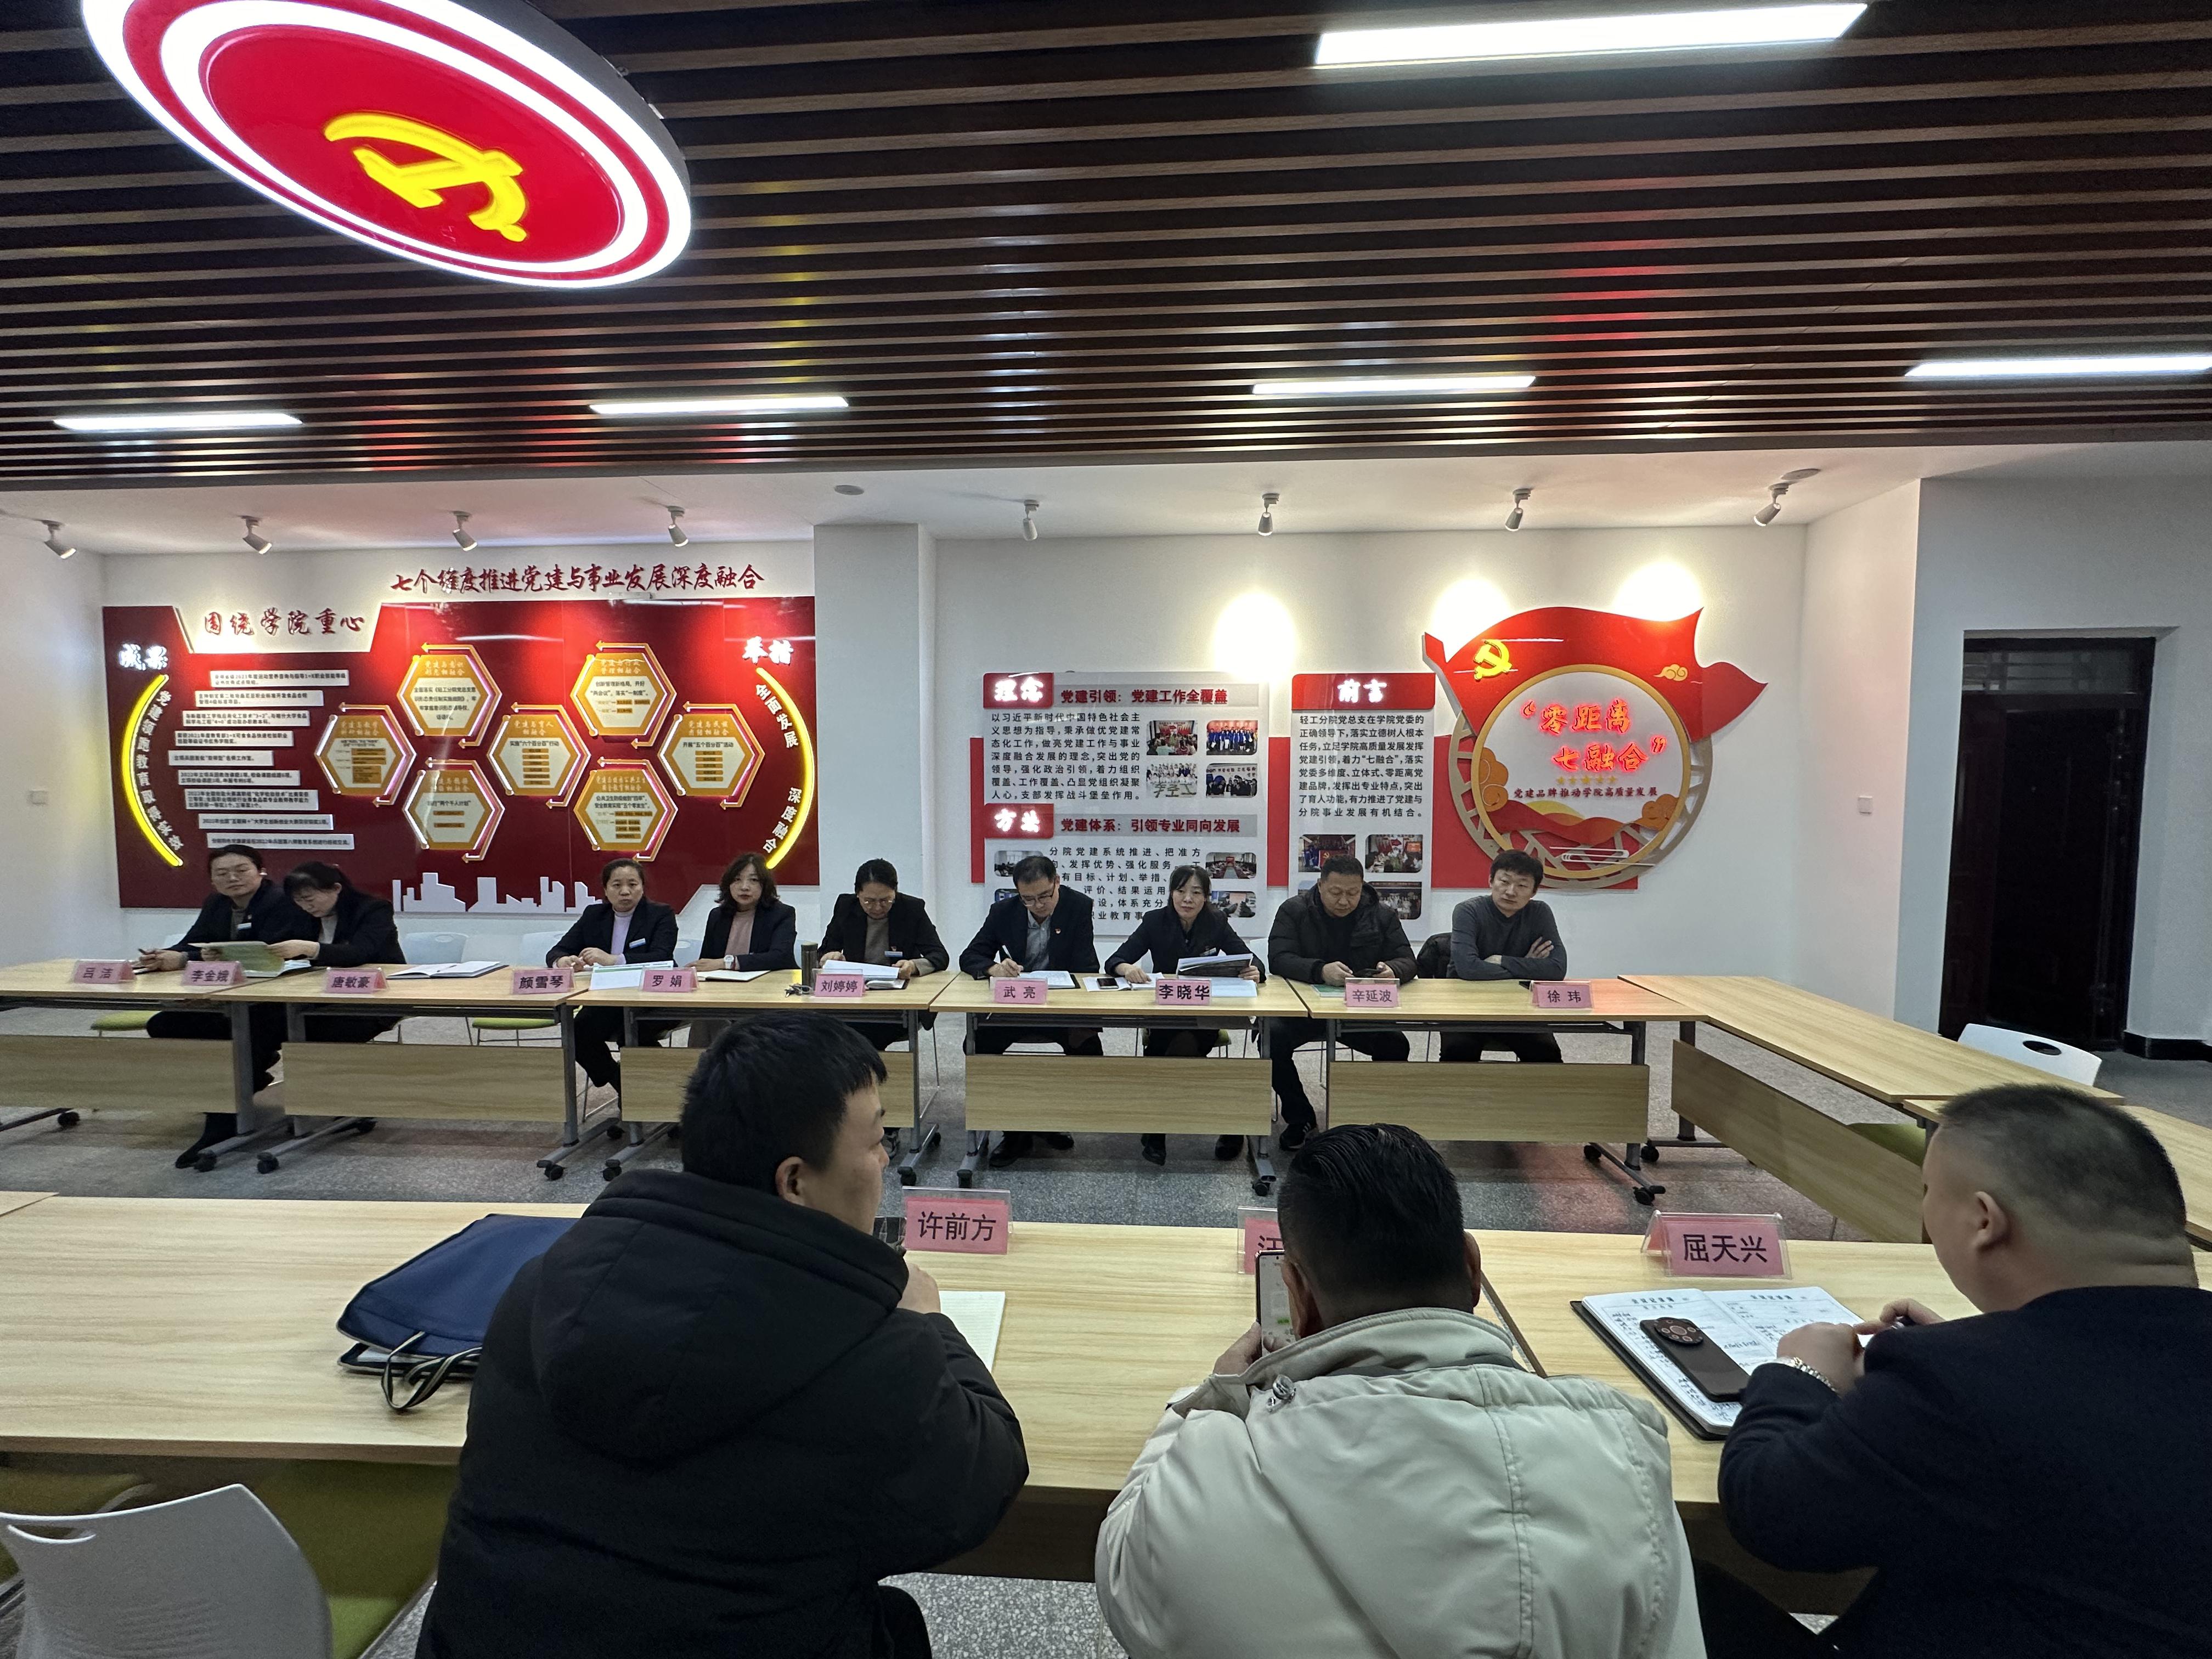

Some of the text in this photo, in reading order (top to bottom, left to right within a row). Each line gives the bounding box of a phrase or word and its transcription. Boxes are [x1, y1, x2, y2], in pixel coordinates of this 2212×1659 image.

[391, 563, 765, 593] 七个维度推进党建与事业发展深度融合
[204, 607, 365, 636] 围绕学院重心
[994, 675, 1045, 703] 理念
[1336, 678, 1388, 703] 前言
[1060, 689, 1228, 705] 党建引领：党建工作全覆盖
[514, 720, 554, 729] 党建与育人
[688, 720, 729, 729] 党建与民族
[1300, 715, 1424, 725] 轻工分院党总支在学院党委的
[991, 725, 1141, 735] 义思想为指导，秉承做优党建常
[1299, 729, 1424, 738] 正确领导下，落实立德树人根本
[991, 738, 1141, 748] 态化工作，做亮党建工作与事业
[1299, 742, 1424, 751] 任务，立足学院高质量发展发挥
[991, 752, 1141, 761] 深度融合发展的理念，突出党的
[1299, 755, 1424, 764] 党建引领，着力“七融合”，落实
[755, 684, 803, 854] 全面发展 深度融合
[991, 765, 1141, 775] 领导，强化政治引领，着力组织
[1299, 769, 1424, 778] 党委多维度、立体式、零距离党
[991, 777, 1141, 787] 覆盖、工作覆盖、凸显党组织凝聚
[1299, 781, 1423, 791] 建品牌，发挥出专业特点，突出
[991, 790, 1141, 800] 人心，支部发挥战斗堡垒作用。
[1514, 786, 1659, 799] 党建品牌推动学院高质量发展
[1299, 794, 1423, 804] 了育人功能，有力推进了党建与
[1299, 808, 1422, 817] 分院事业发展有机结合。
[1061, 817, 1240, 833] 党建体系：引领专业同向发展
[1049, 847, 1201, 856] 分院党建系统推进、把准方
[518, 974, 564, 989] 颜雪琴
[651, 974, 682, 988] 罗娟
[821, 980, 859, 993] 刘婷婷
[1003, 985, 1036, 999] 武亮
[1159, 984, 1210, 1001] 李晓华
[1352, 989, 1393, 1003] 辛延波
[1547, 990, 1582, 1003] 徐玮
[917, 1210, 997, 1242] 许前方
[1683, 1233, 1768, 1263] 屈天兴
